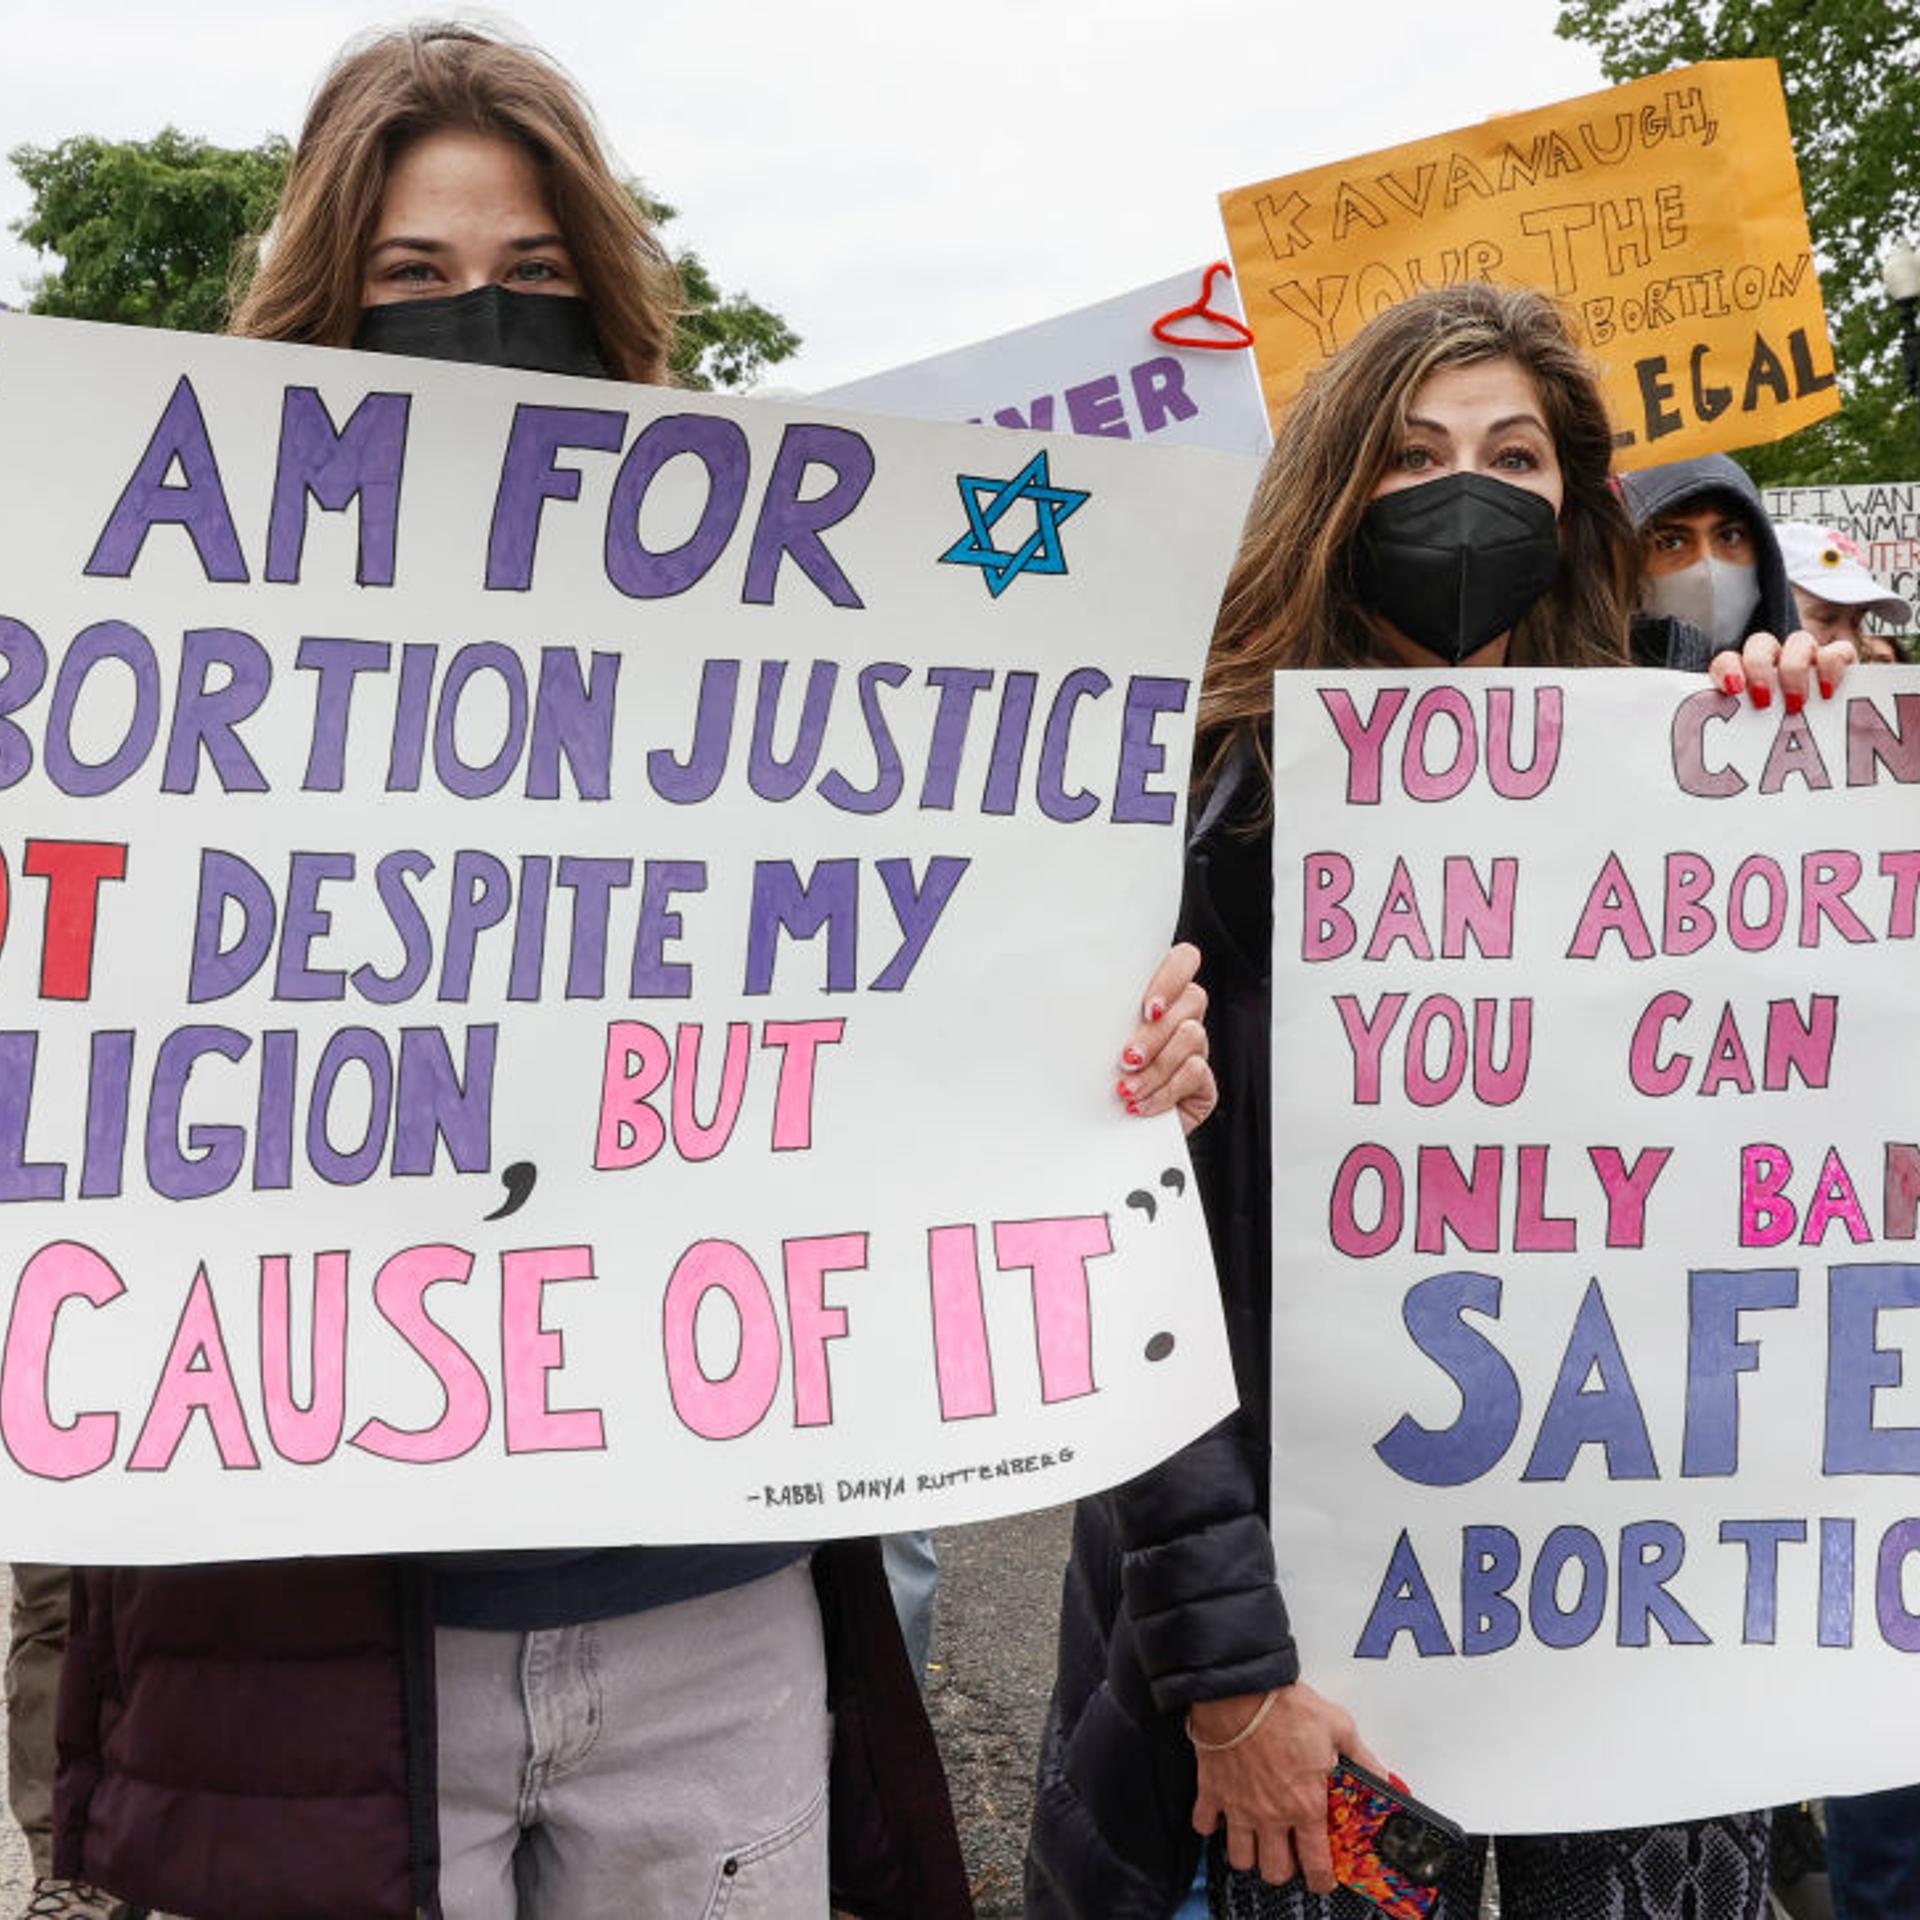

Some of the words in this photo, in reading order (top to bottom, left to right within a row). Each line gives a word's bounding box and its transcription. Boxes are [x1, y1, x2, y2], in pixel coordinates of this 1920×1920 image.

[1253, 86, 1718, 262] KAVANAUGH,
[1519, 184, 1689, 298] THE
[1583, 253, 1811, 347] BORTION
[1611, 326, 1836, 448] EGAL
[83, 373, 413, 588] AM
[484, 402, 877, 610] FOR
[1767, 488, 1807, 517] IF
[1809, 488, 1834, 517] I
[1840, 484, 1920, 515] WAN
[0, 614, 622, 800] BORTION
[646, 659, 1191, 825] JUSTICE
[1316, 685, 1564, 805] YOU
[1671, 688, 1920, 799] CAN
[0, 838, 128, 1002] T
[187, 846, 709, 1006] DESPITE
[742, 855, 972, 997] MY
[1300, 851, 1519, 963] BAN
[1565, 848, 1920, 961] ABORT
[1331, 992, 1534, 1108] YOU
[1628, 990, 1840, 1098] CAN
[0, 1022, 538, 1222] LIGION,
[590, 1017, 847, 1171] BUT
[1329, 1142, 1674, 1260] ONLY
[0, 1240, 608, 1482] CAUSE
[661, 1231, 870, 1441] OF
[1373, 1262, 1920, 1488] SAFE
[836, 1474, 906, 1504] DANYA
[916, 1448, 1076, 1491] RUTTENBERG
